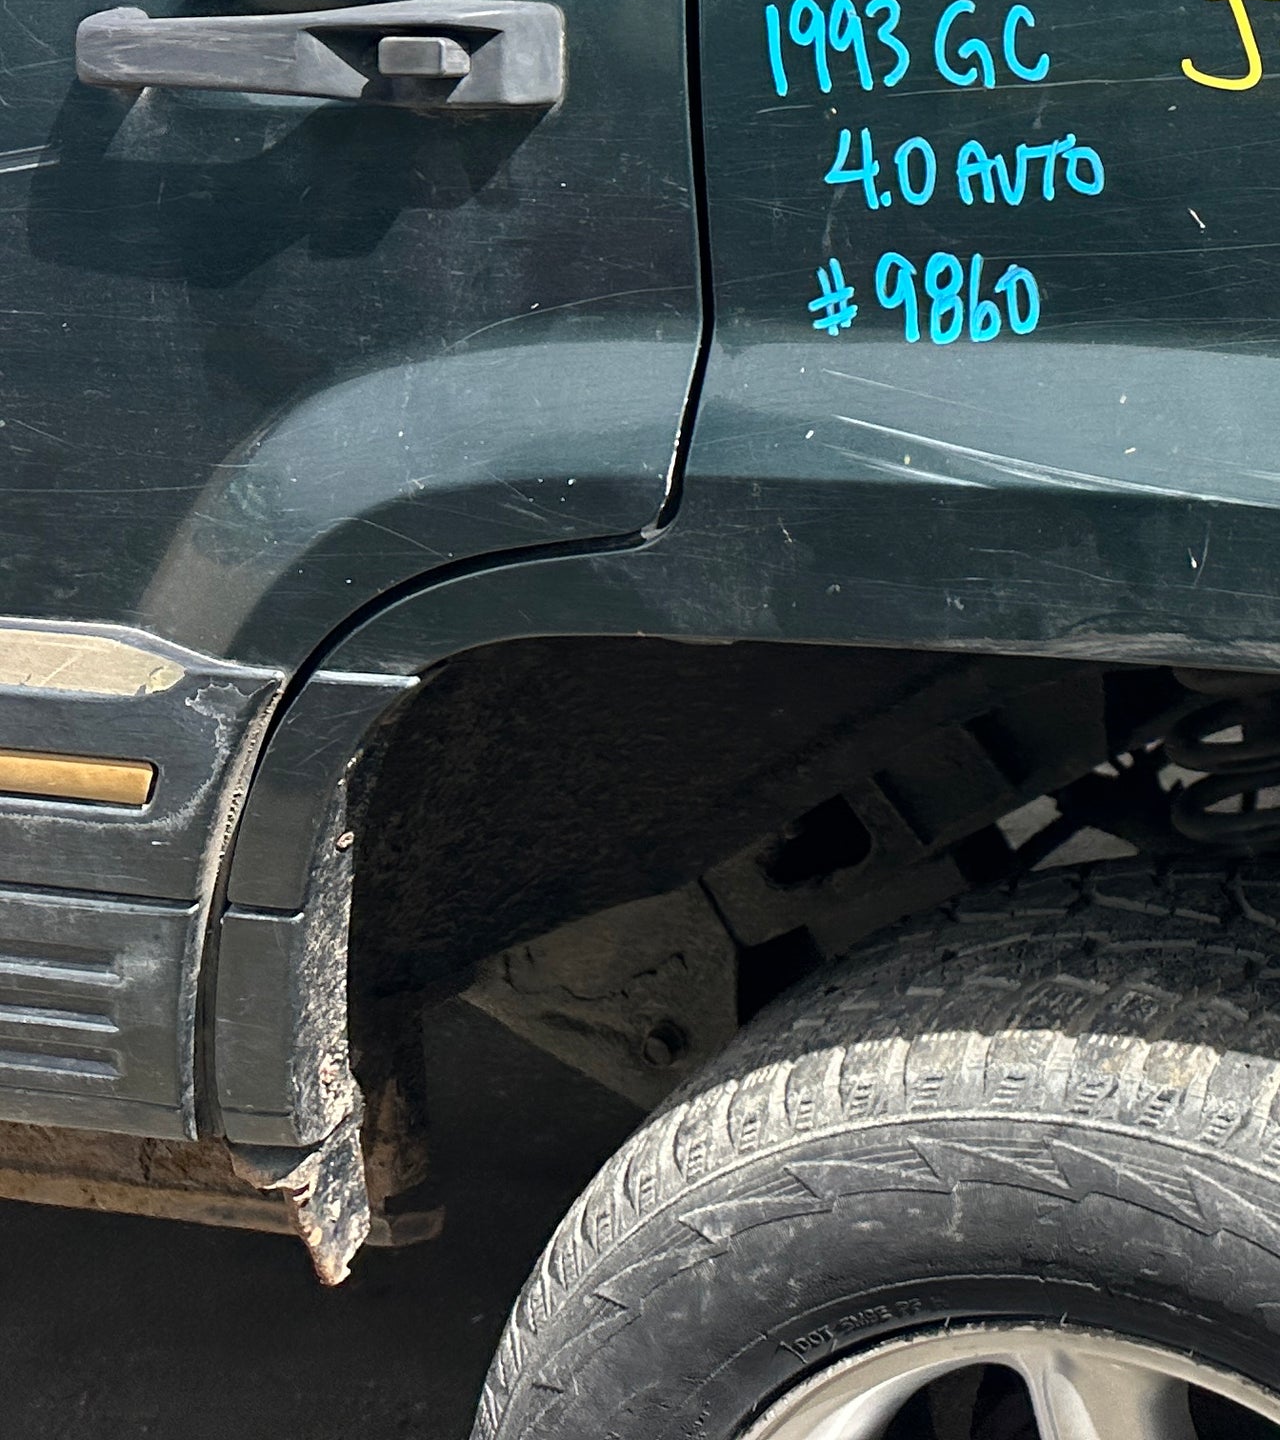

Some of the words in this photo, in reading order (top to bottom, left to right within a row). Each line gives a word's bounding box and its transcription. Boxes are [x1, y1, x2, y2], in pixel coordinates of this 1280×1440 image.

[823, 127, 938, 210] 4.0
[956, 133, 1105, 205] AUTO
[874, 250, 1041, 347] 9860
